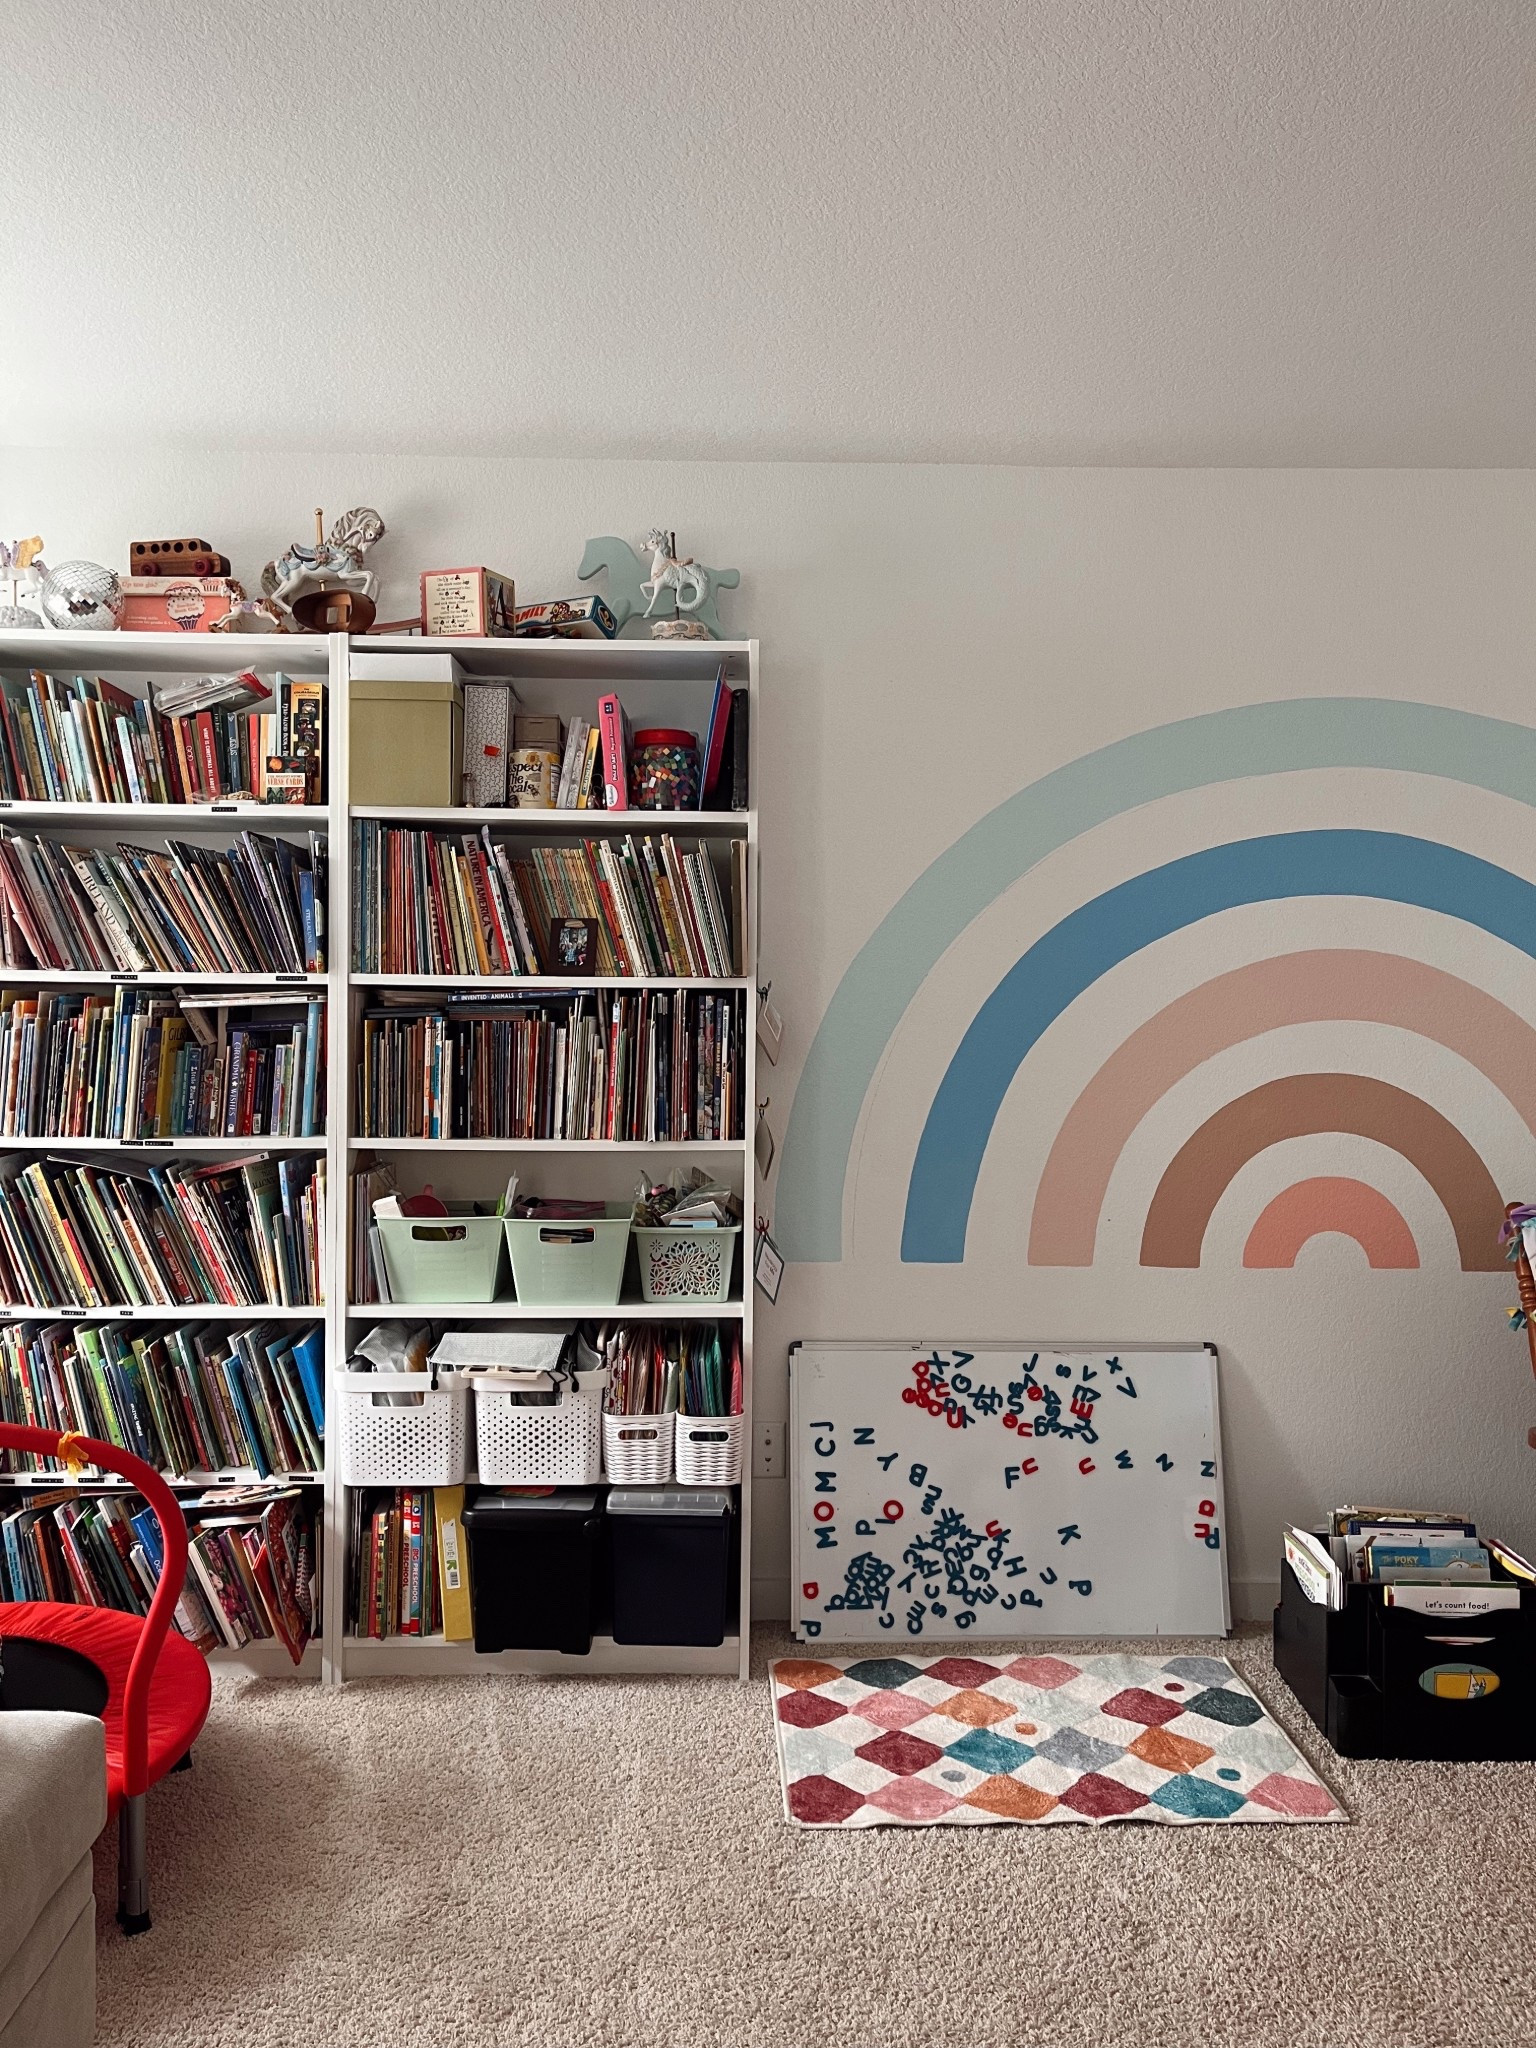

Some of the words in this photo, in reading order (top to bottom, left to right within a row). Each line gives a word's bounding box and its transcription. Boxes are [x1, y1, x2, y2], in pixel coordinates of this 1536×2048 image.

[186, 745, 194, 762] GOD
[230, 736, 238, 756] JESUS
[268, 778, 285, 786] VERSE
[465, 840, 481, 875] NATURE
[473, 874, 484, 886] IN
[83, 874, 117, 927] IRELAND
[474, 885, 494, 927] AMERICA
[305, 909, 313, 944] STELLALUNA
[490, 992, 515, 1000] ANIMALS
[231, 1042, 241, 1081] GRANDMA
[229, 1088, 237, 1117] WISHES
[174, 1272, 185, 1286] Tales
[1004, 1466, 1020, 1490] F
[401, 1543, 411, 1588] PRESCHOOL
[412, 1548, 420, 1561] BIG
[411, 1563, 420, 1604] PRESCHOOL
[1468, 1602, 1489, 1610] food!
